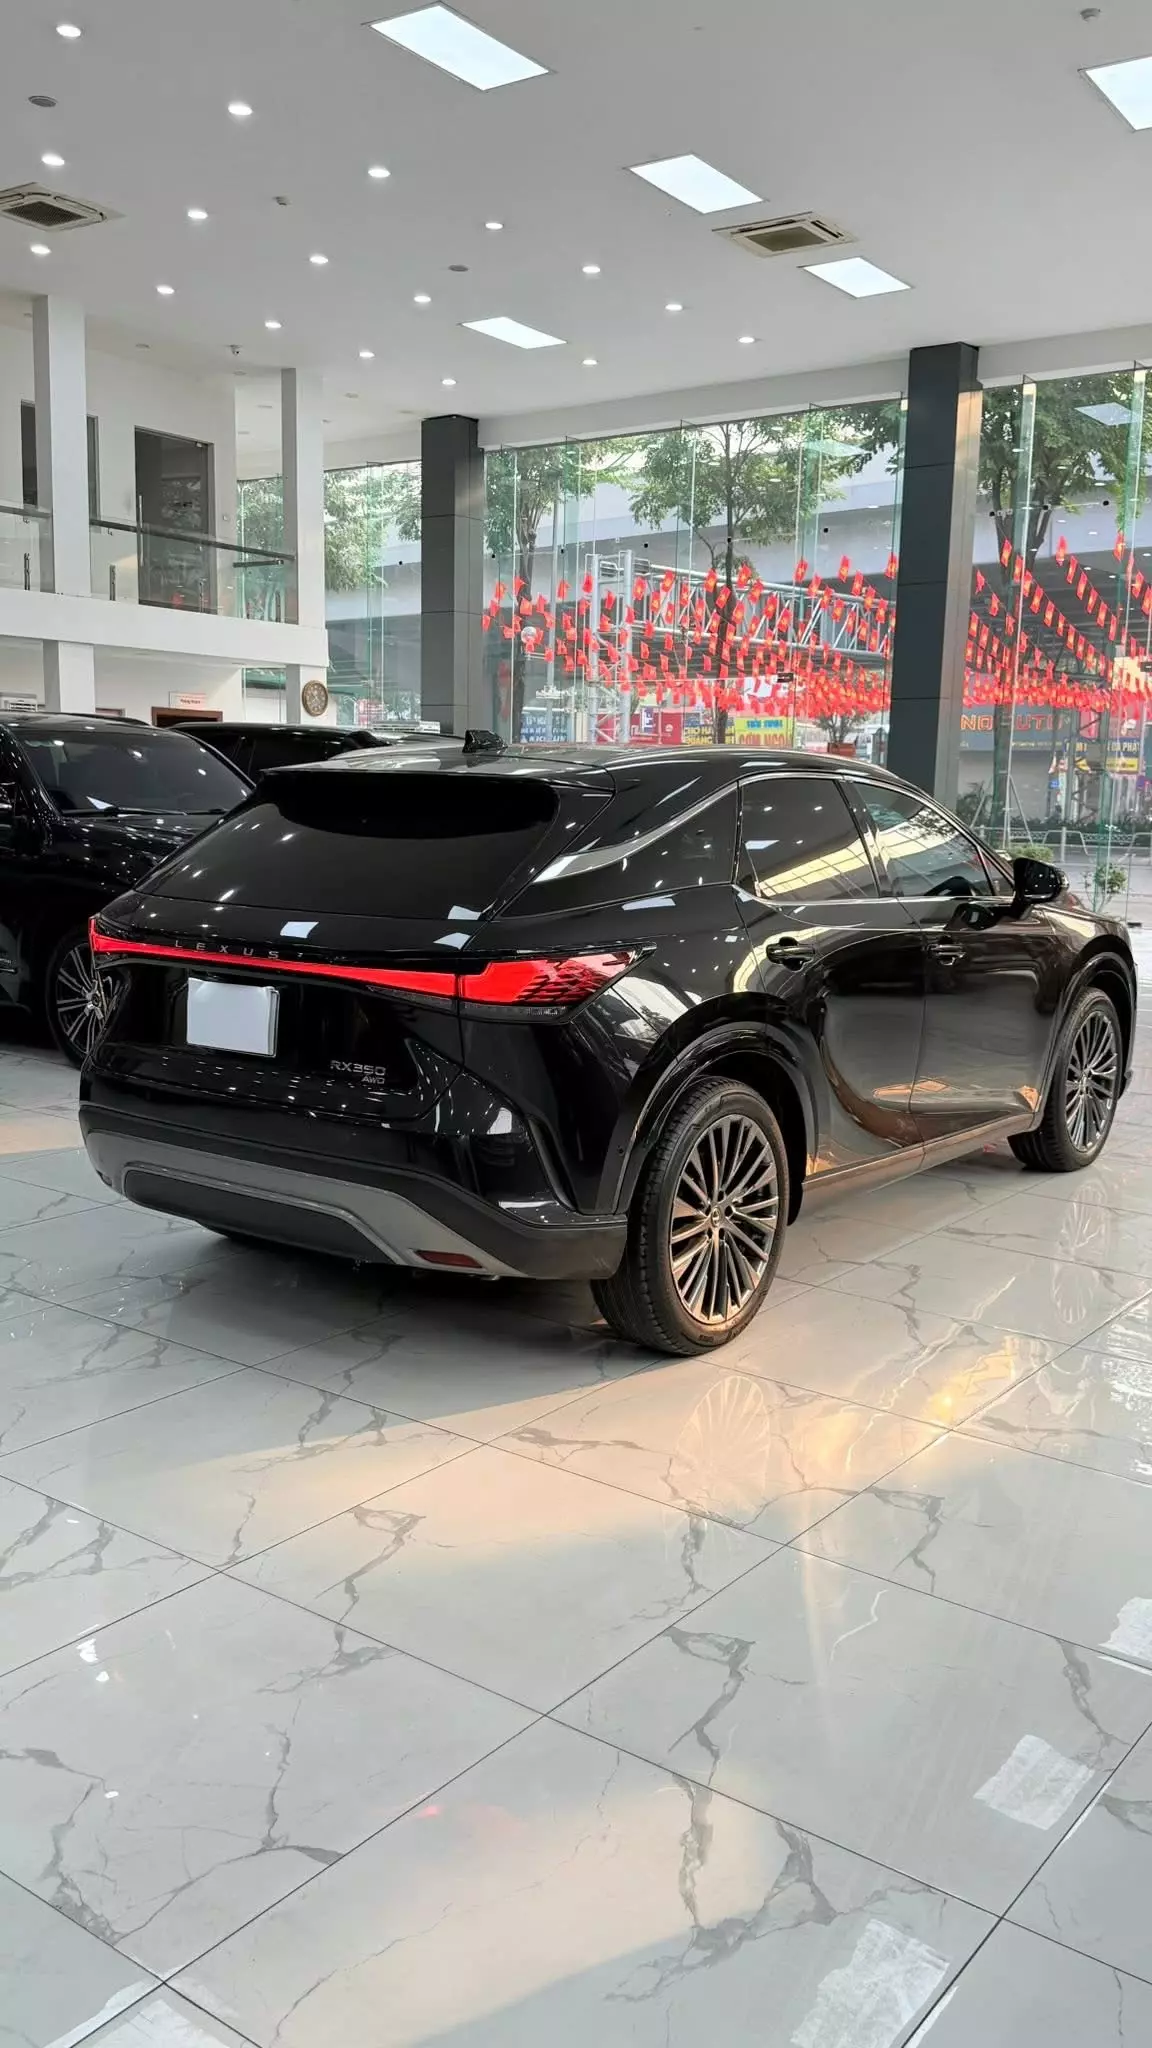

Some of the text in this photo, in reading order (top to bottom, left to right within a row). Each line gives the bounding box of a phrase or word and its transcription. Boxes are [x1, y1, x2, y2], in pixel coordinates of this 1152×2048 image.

[175, 939, 280, 960] LEXUS
[330, 1060, 386, 1076] RX350
[361, 1075, 386, 1085] AWD
